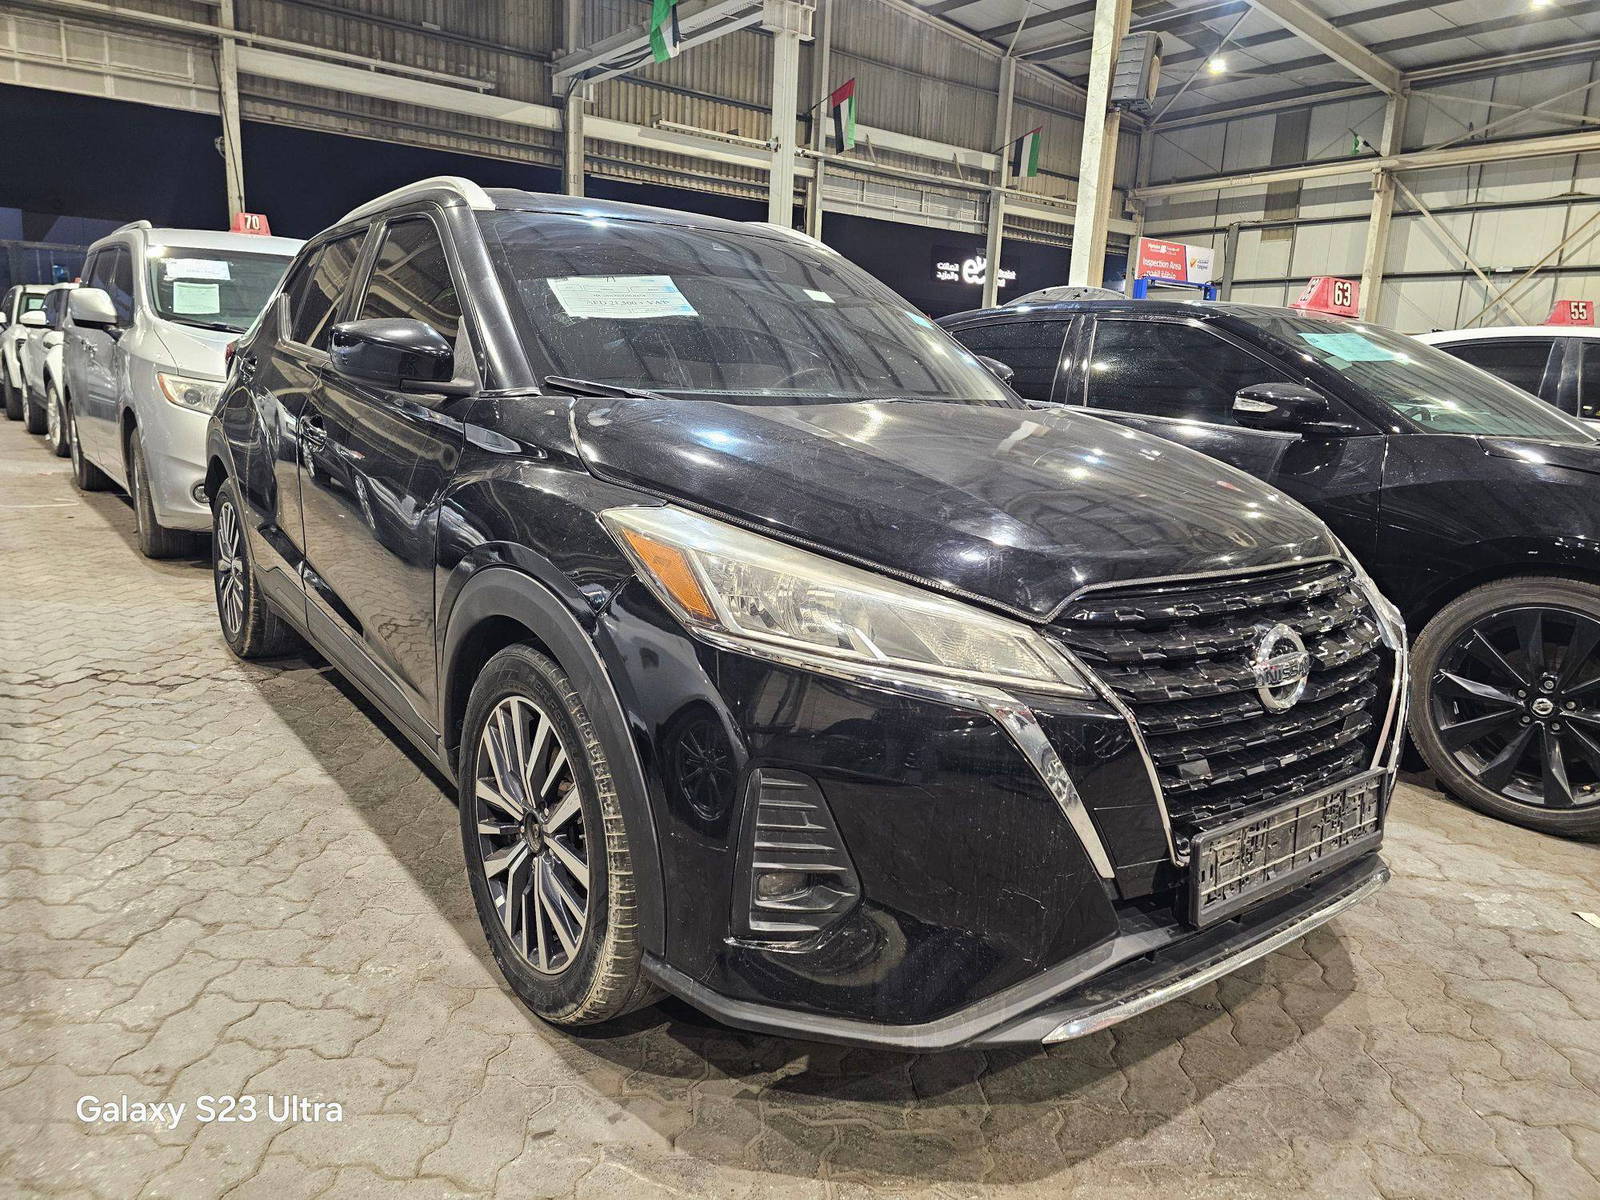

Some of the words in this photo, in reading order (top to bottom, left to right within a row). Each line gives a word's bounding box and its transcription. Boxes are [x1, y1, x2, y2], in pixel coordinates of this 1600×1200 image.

[245, 215, 260, 230] 70
[1143, 257, 1170, 269] Inspection
[1170, 261, 1182, 271] Area
[1334, 281, 1352, 307] 63
[1570, 301, 1587, 320] 55
[1261, 655, 1309, 685] NISSAN
